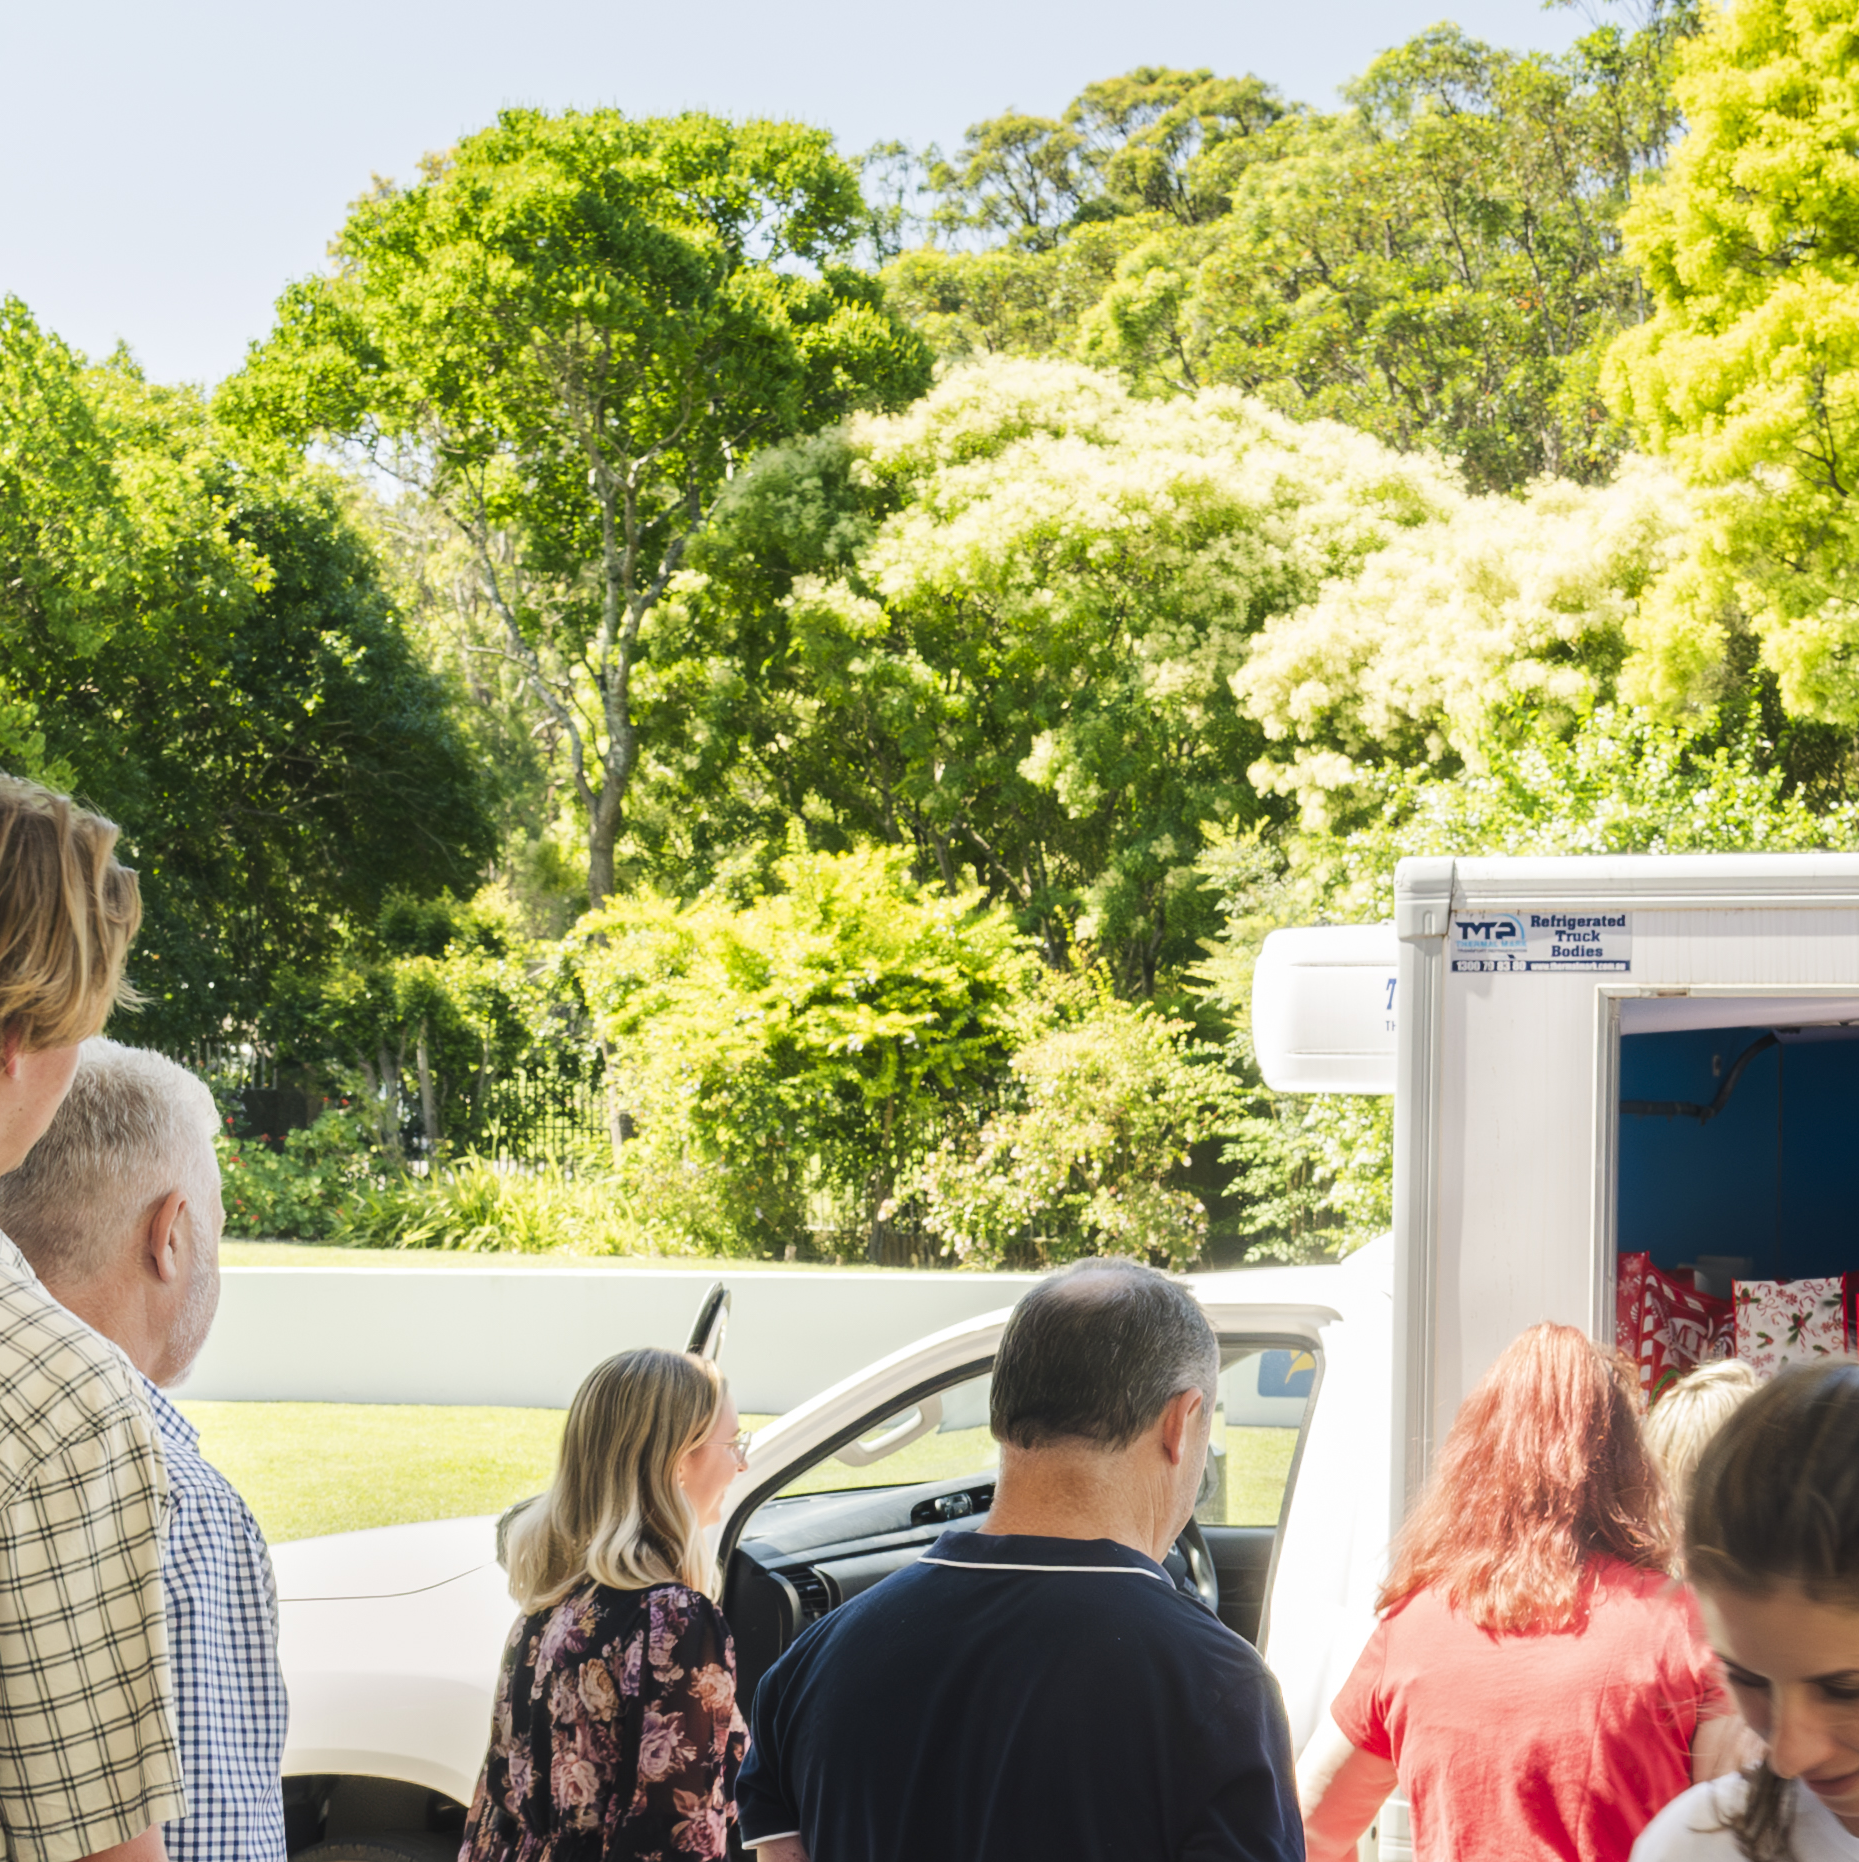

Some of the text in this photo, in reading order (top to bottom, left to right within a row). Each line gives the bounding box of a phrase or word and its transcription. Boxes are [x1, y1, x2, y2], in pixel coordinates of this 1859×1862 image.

[1530, 914, 1626, 930] Refrigerated
[1555, 930, 1601, 942] Truck
[1551, 945, 1603, 957] Bodies
[1457, 961, 1480, 971] 1300
[1483, 961, 1495, 971] 79
[1497, 961, 1511, 971] 83
